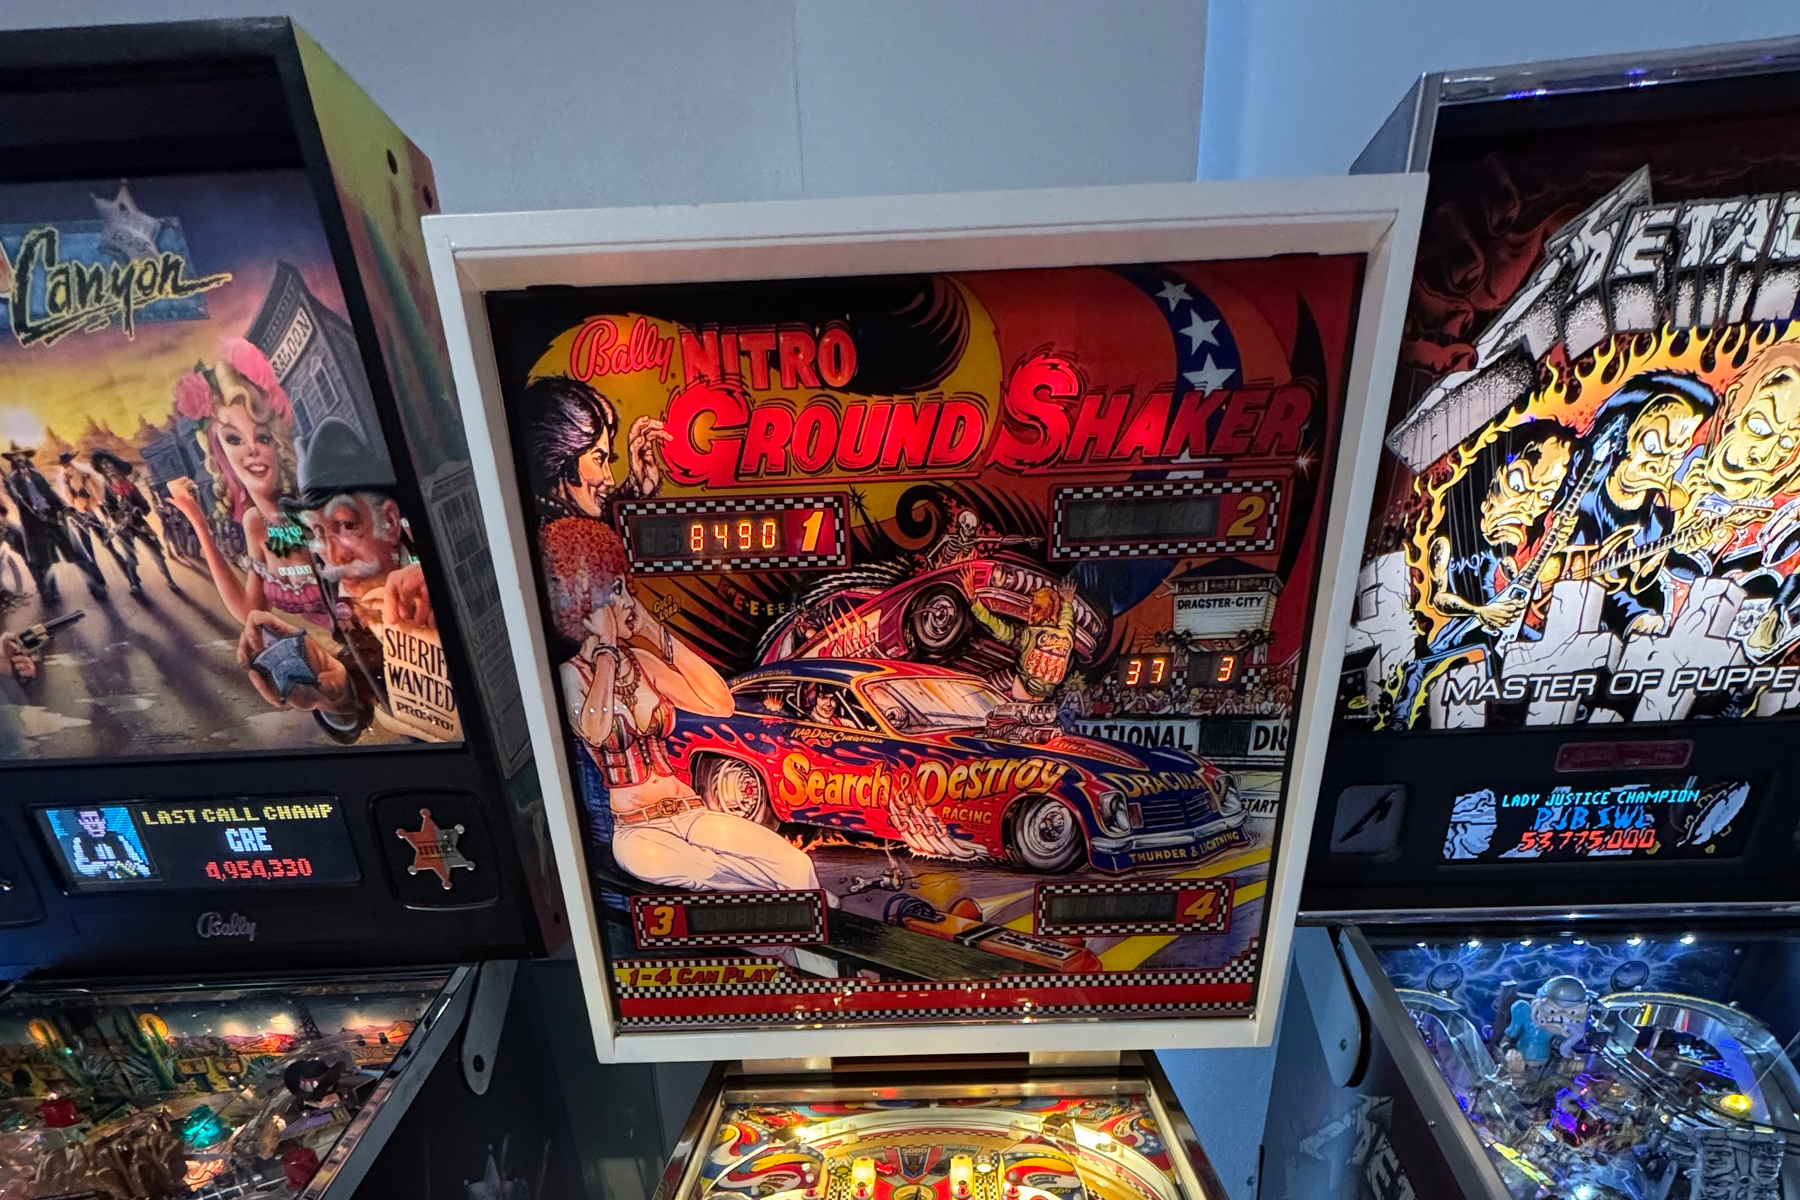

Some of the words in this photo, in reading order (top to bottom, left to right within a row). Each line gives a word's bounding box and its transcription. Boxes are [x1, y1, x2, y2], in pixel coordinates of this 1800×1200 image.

[9, 227, 232, 347] Canyon
[272, 311, 310, 378] SALOON
[570, 317, 674, 383] Bally
[679, 324, 857, 391] NITRO
[661, 380, 984, 488] GROUND
[991, 354, 1314, 472] SHAKER
[801, 511, 824, 552] 1
[1226, 496, 1265, 538] 2
[690, 523, 776, 551] 8490
[1126, 658, 1165, 685] 37
[1217, 656, 1234, 682] 3
[1443, 675, 1595, 702] MASTER
[1610, 671, 1662, 695] OF
[1671, 666, 1800, 692] PUPPE
[387, 662, 455, 712] WANTED
[396, 701, 453, 731] PRONTO!
[779, 752, 892, 808] Search
[1502, 794, 1540, 807] LADY
[1545, 792, 1611, 806] JUSTICE
[1617, 789, 1700, 804] CHAMPION
[142, 809, 197, 825] LAST
[202, 807, 260, 823] CALL
[263, 804, 333, 820] CHAMP
[942, 807, 993, 825] RACING
[1129, 848, 1187, 863] THUNDER
[1200, 831, 1239, 855] LIGHTNING
[650, 907, 675, 936] 3
[1183, 892, 1215, 920] 4
[197, 912, 257, 941] Bally
[677, 968, 718, 984] CAN
[722, 966, 778, 984] PLAY
